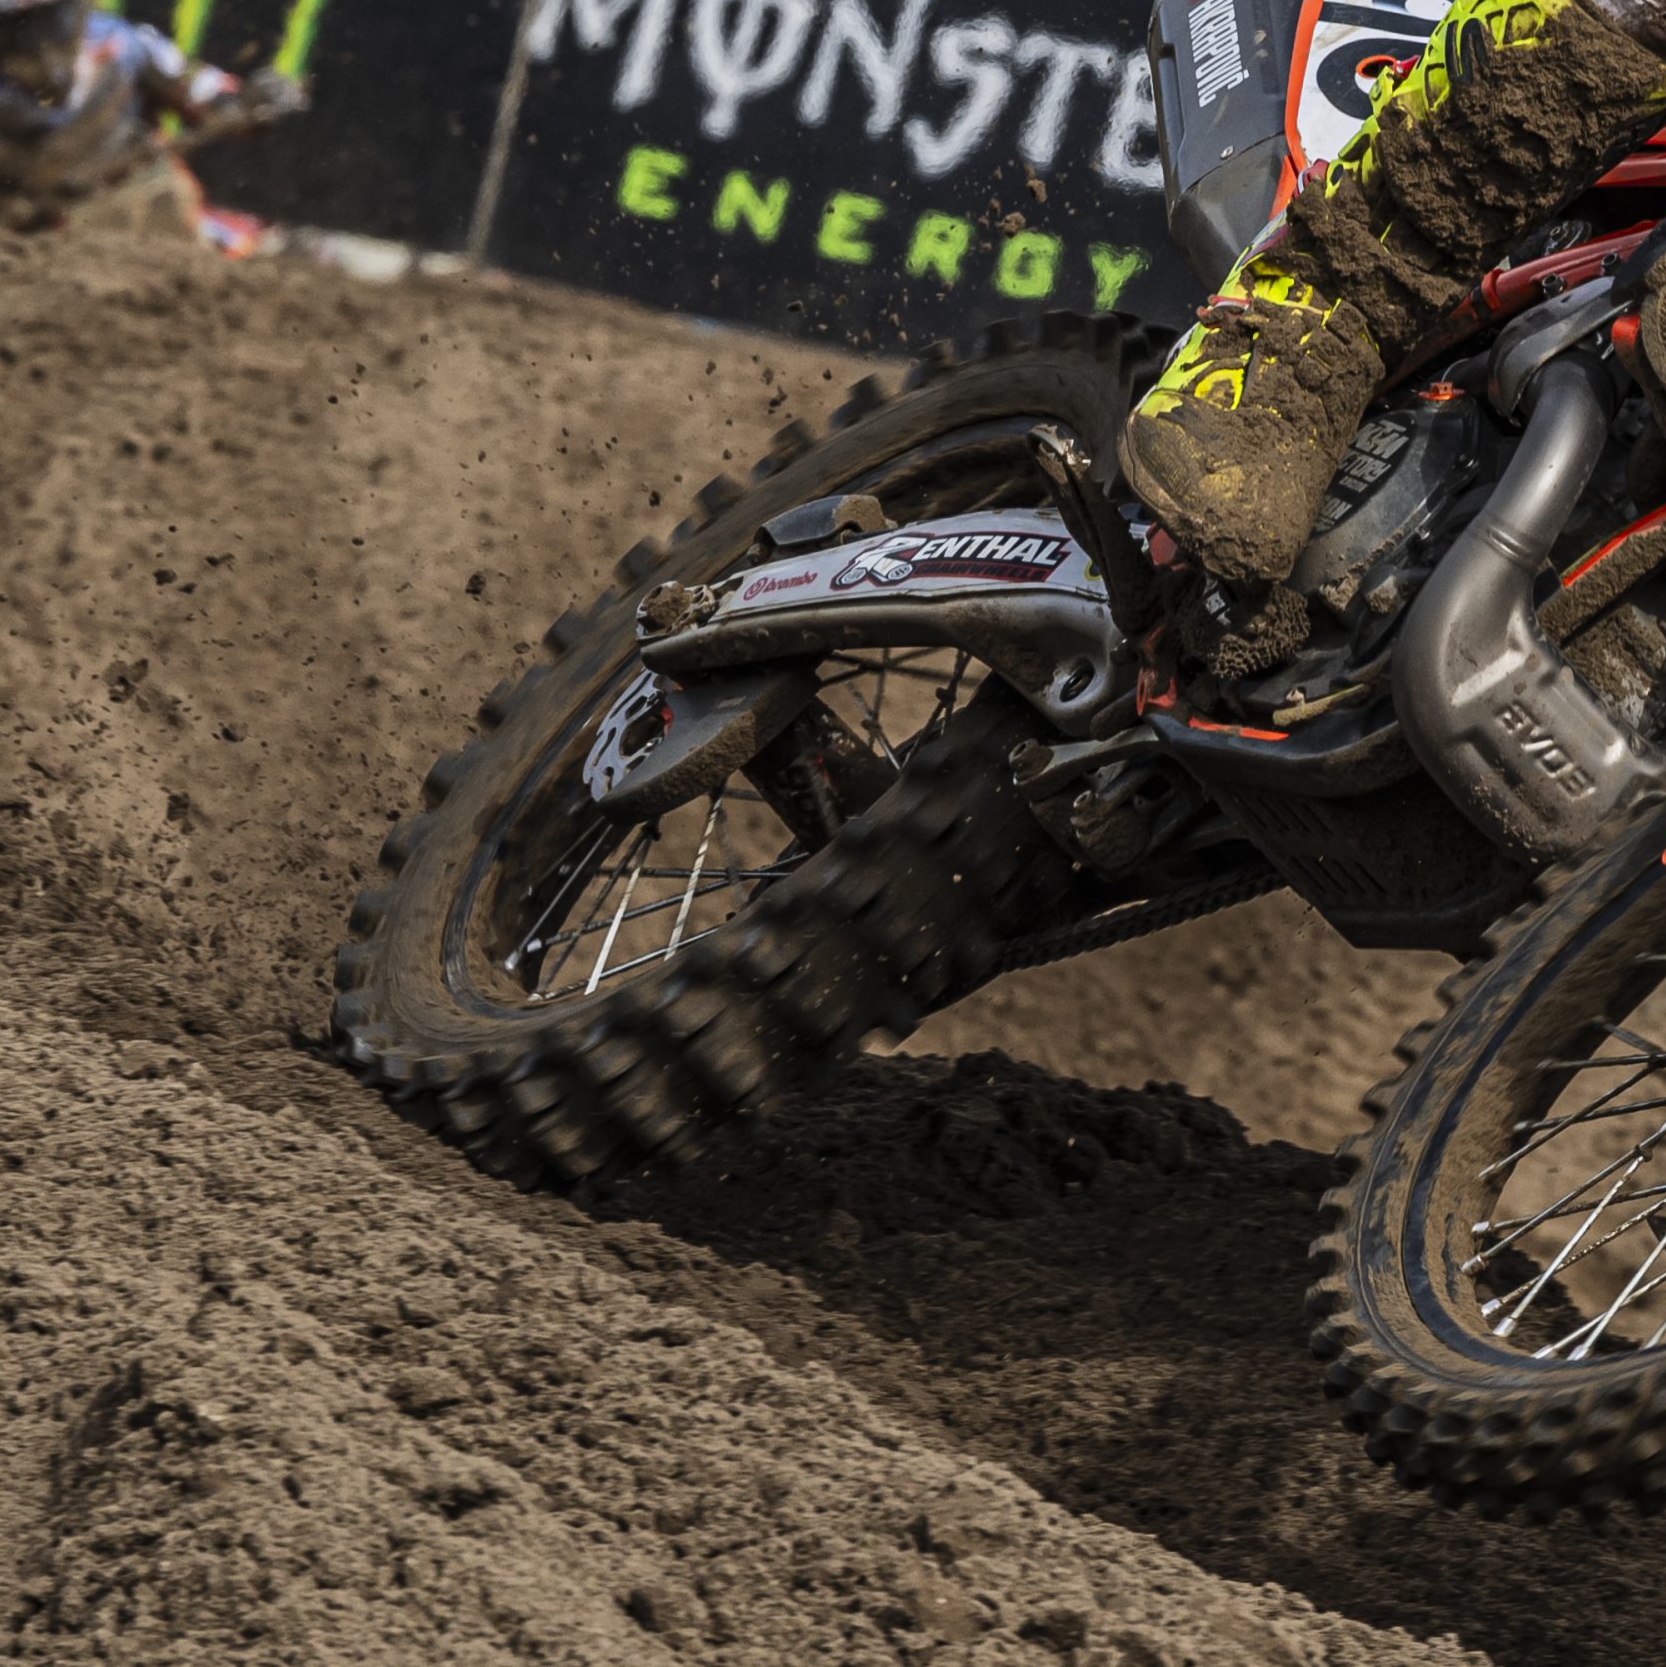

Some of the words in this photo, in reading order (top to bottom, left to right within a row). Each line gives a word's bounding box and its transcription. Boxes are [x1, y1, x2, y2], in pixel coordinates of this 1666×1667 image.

[617, 144, 1150, 313] ENERGY
[763, 570, 819, 594] brembo
[836, 533, 1067, 590] RENTHAL
